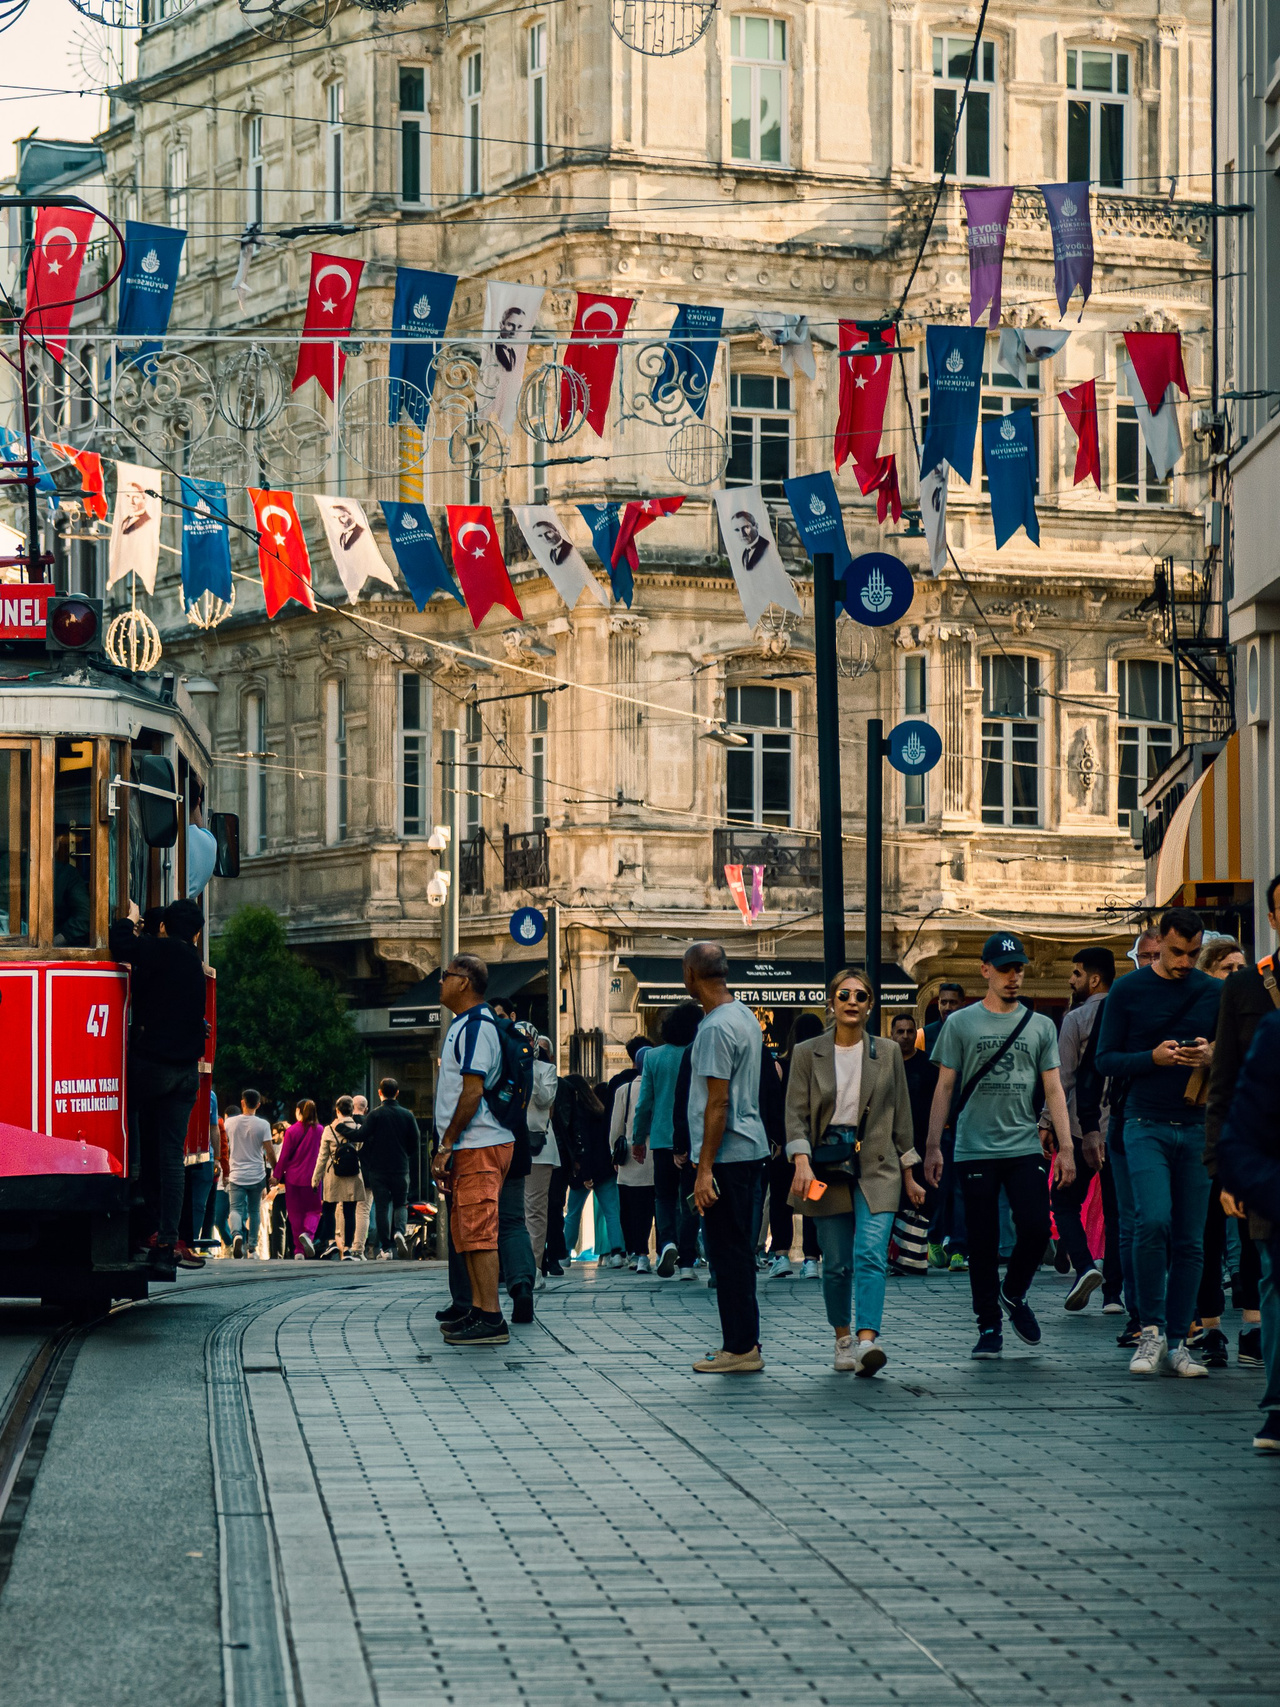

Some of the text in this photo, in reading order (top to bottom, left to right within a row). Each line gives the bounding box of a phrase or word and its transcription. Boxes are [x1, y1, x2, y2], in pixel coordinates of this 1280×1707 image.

[734, 990, 760, 1001] SETA
[761, 990, 796, 1001] SILVER
[799, 990, 806, 1001] &
[86, 1004, 110, 1037] 47
[54, 1077, 119, 1094] ASILMAK YASAK
[55, 1094, 119, 1114] VE TEHLİKELİDİR
